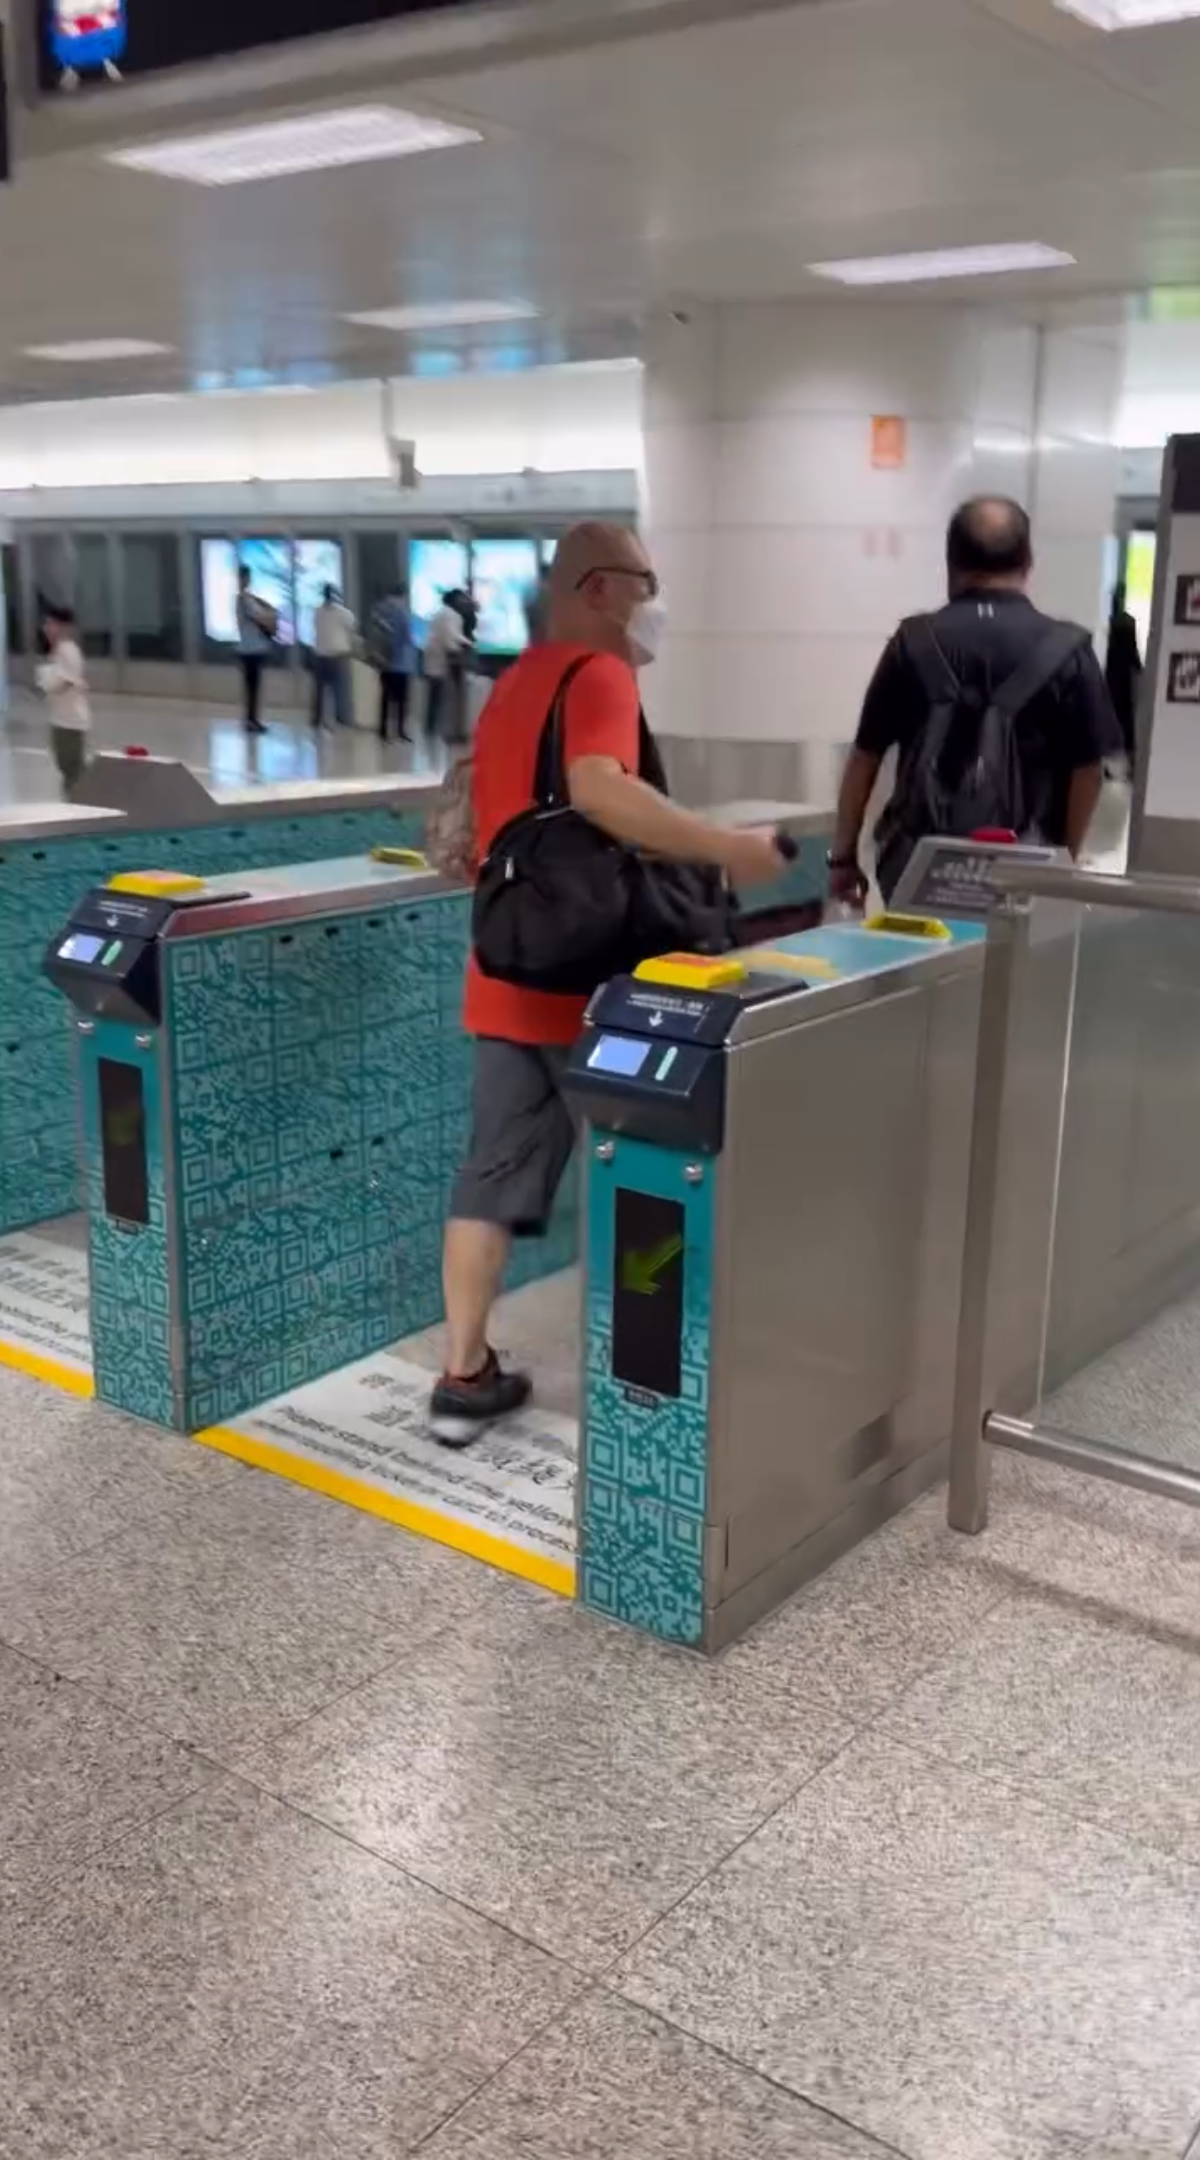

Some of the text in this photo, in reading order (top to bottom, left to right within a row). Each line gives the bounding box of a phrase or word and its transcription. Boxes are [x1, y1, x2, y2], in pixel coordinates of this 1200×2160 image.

[333, 1429, 395, 1456] stand
[389, 1450, 467, 1484] behind
[463, 1480, 504, 1500] the
